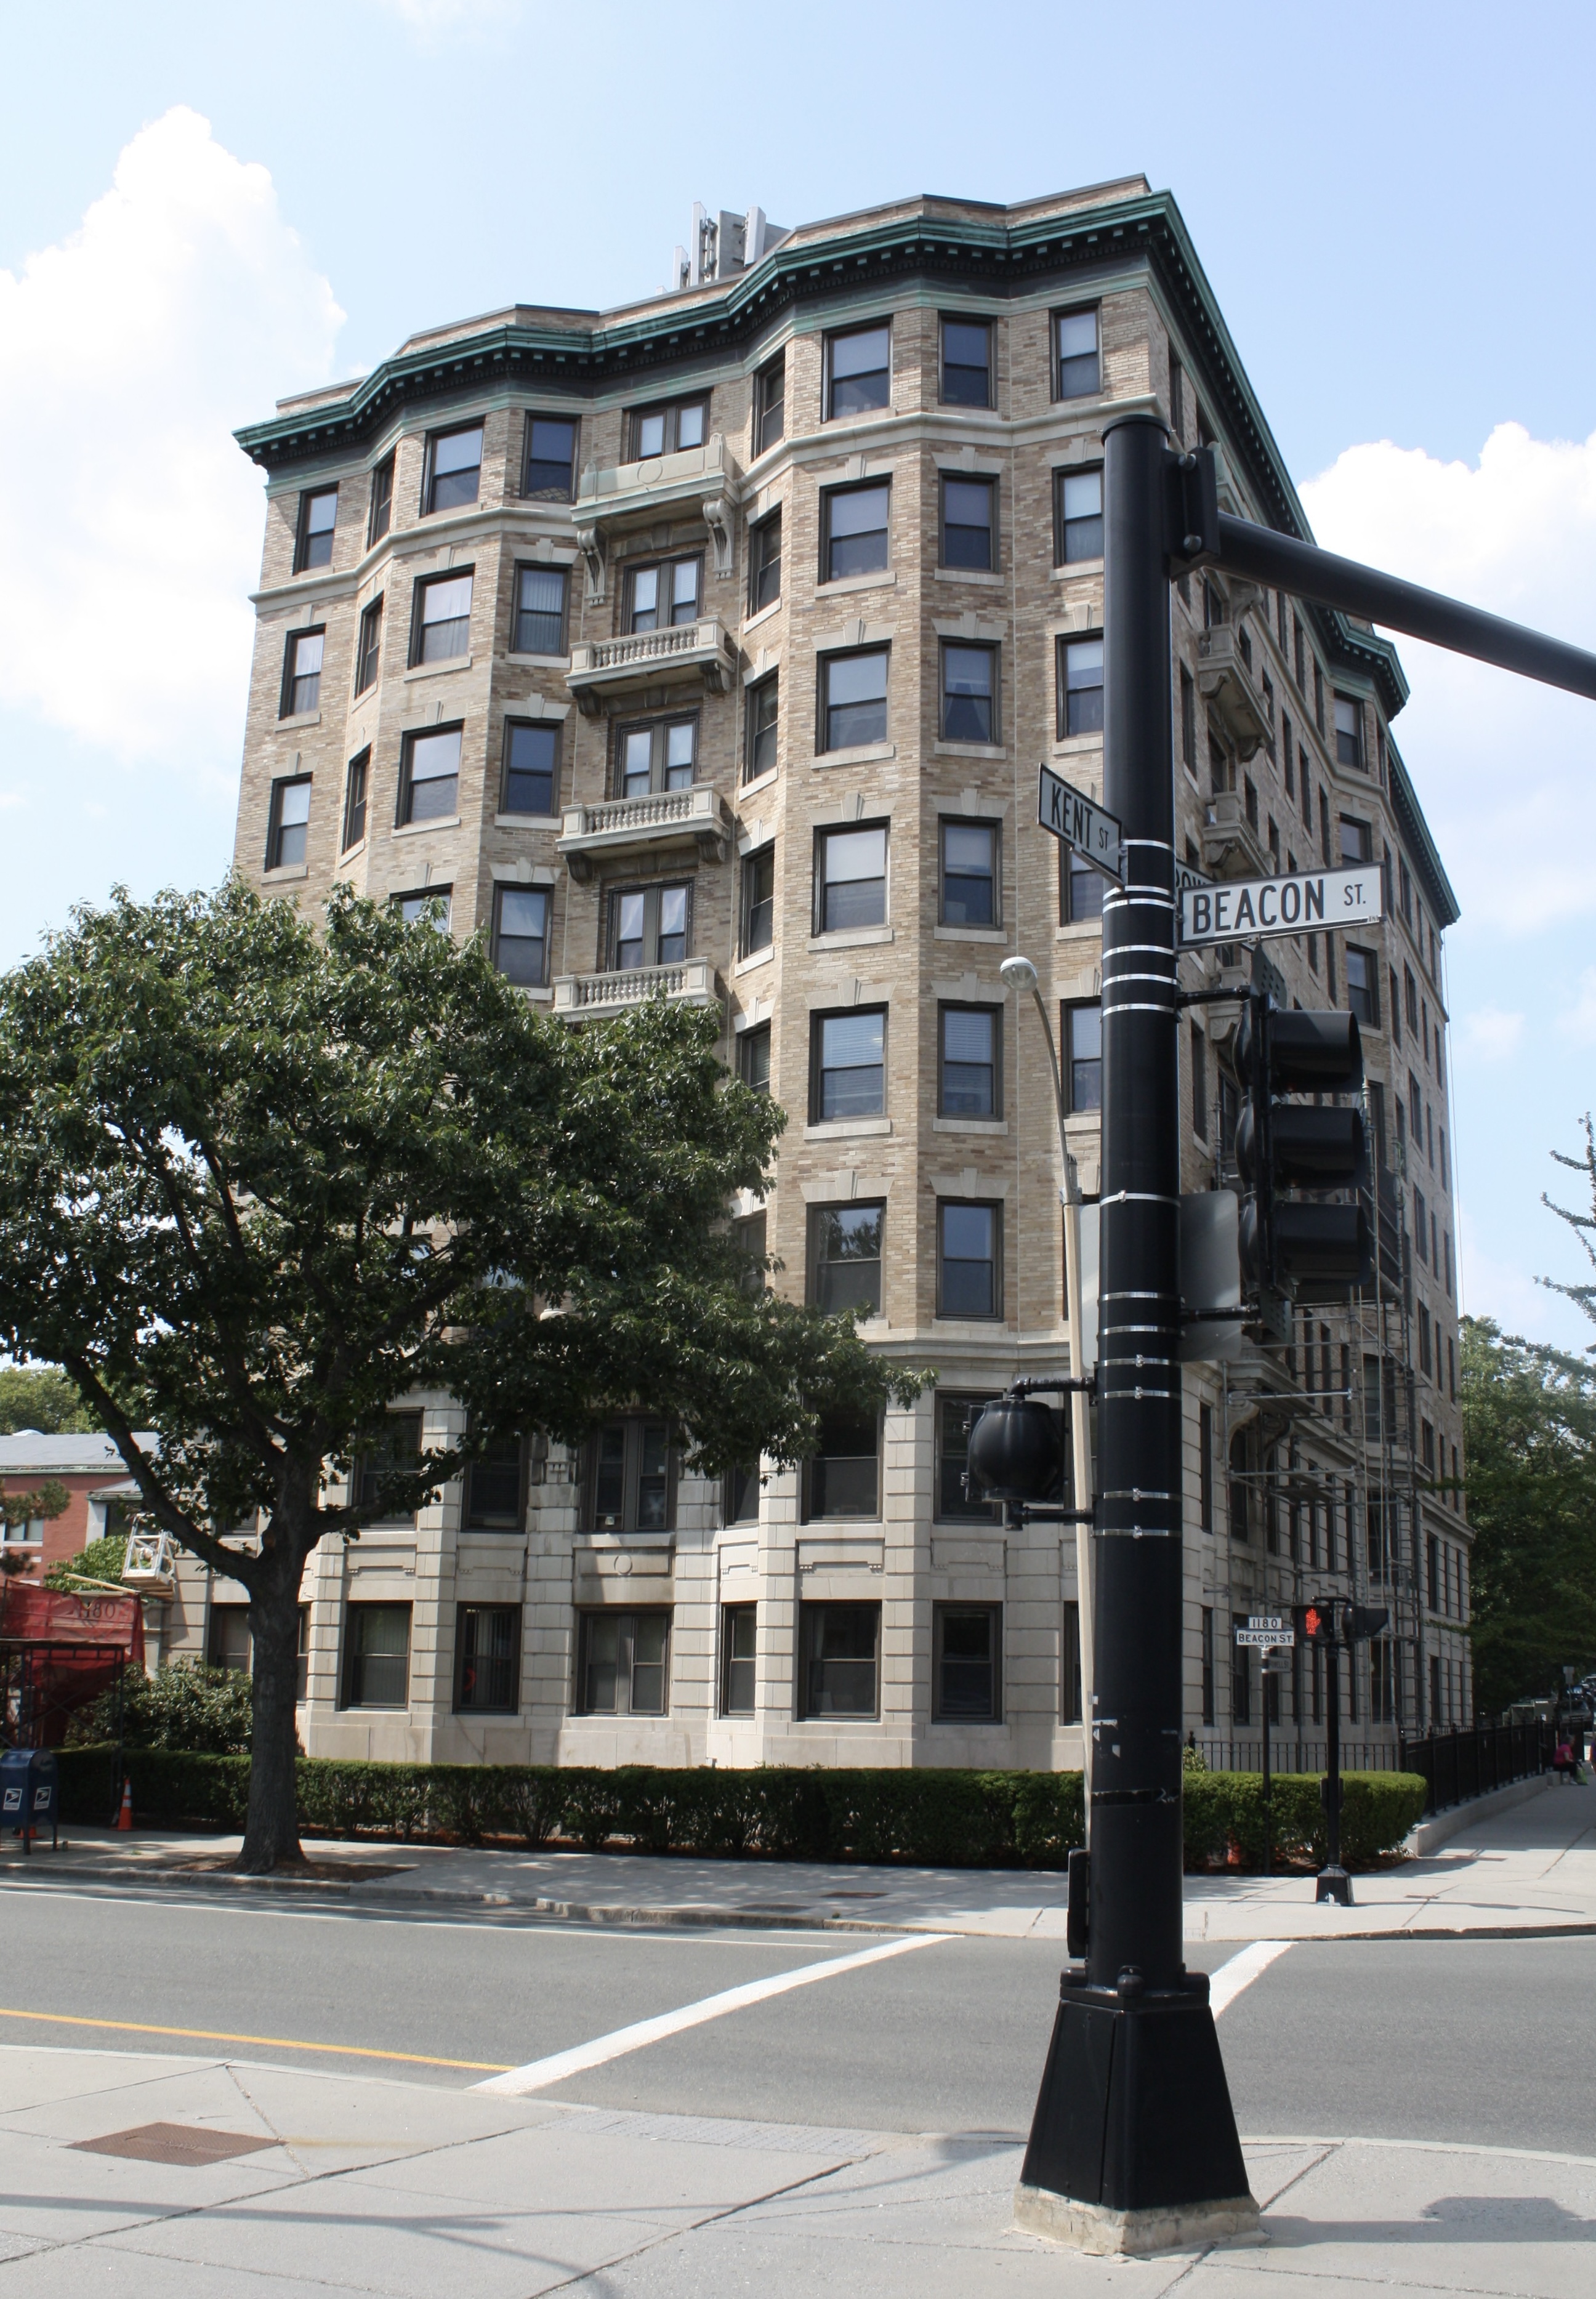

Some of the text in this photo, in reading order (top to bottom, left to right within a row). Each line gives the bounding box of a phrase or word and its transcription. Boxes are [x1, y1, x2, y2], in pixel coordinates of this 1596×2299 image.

[1051, 782, 1108, 851] KENT ST
[1193, 879, 1366, 935] BEACON ST.
[1239, 1633, 1293, 1643] BEACON ST.
[1252, 1618, 1278, 1629] 1180
